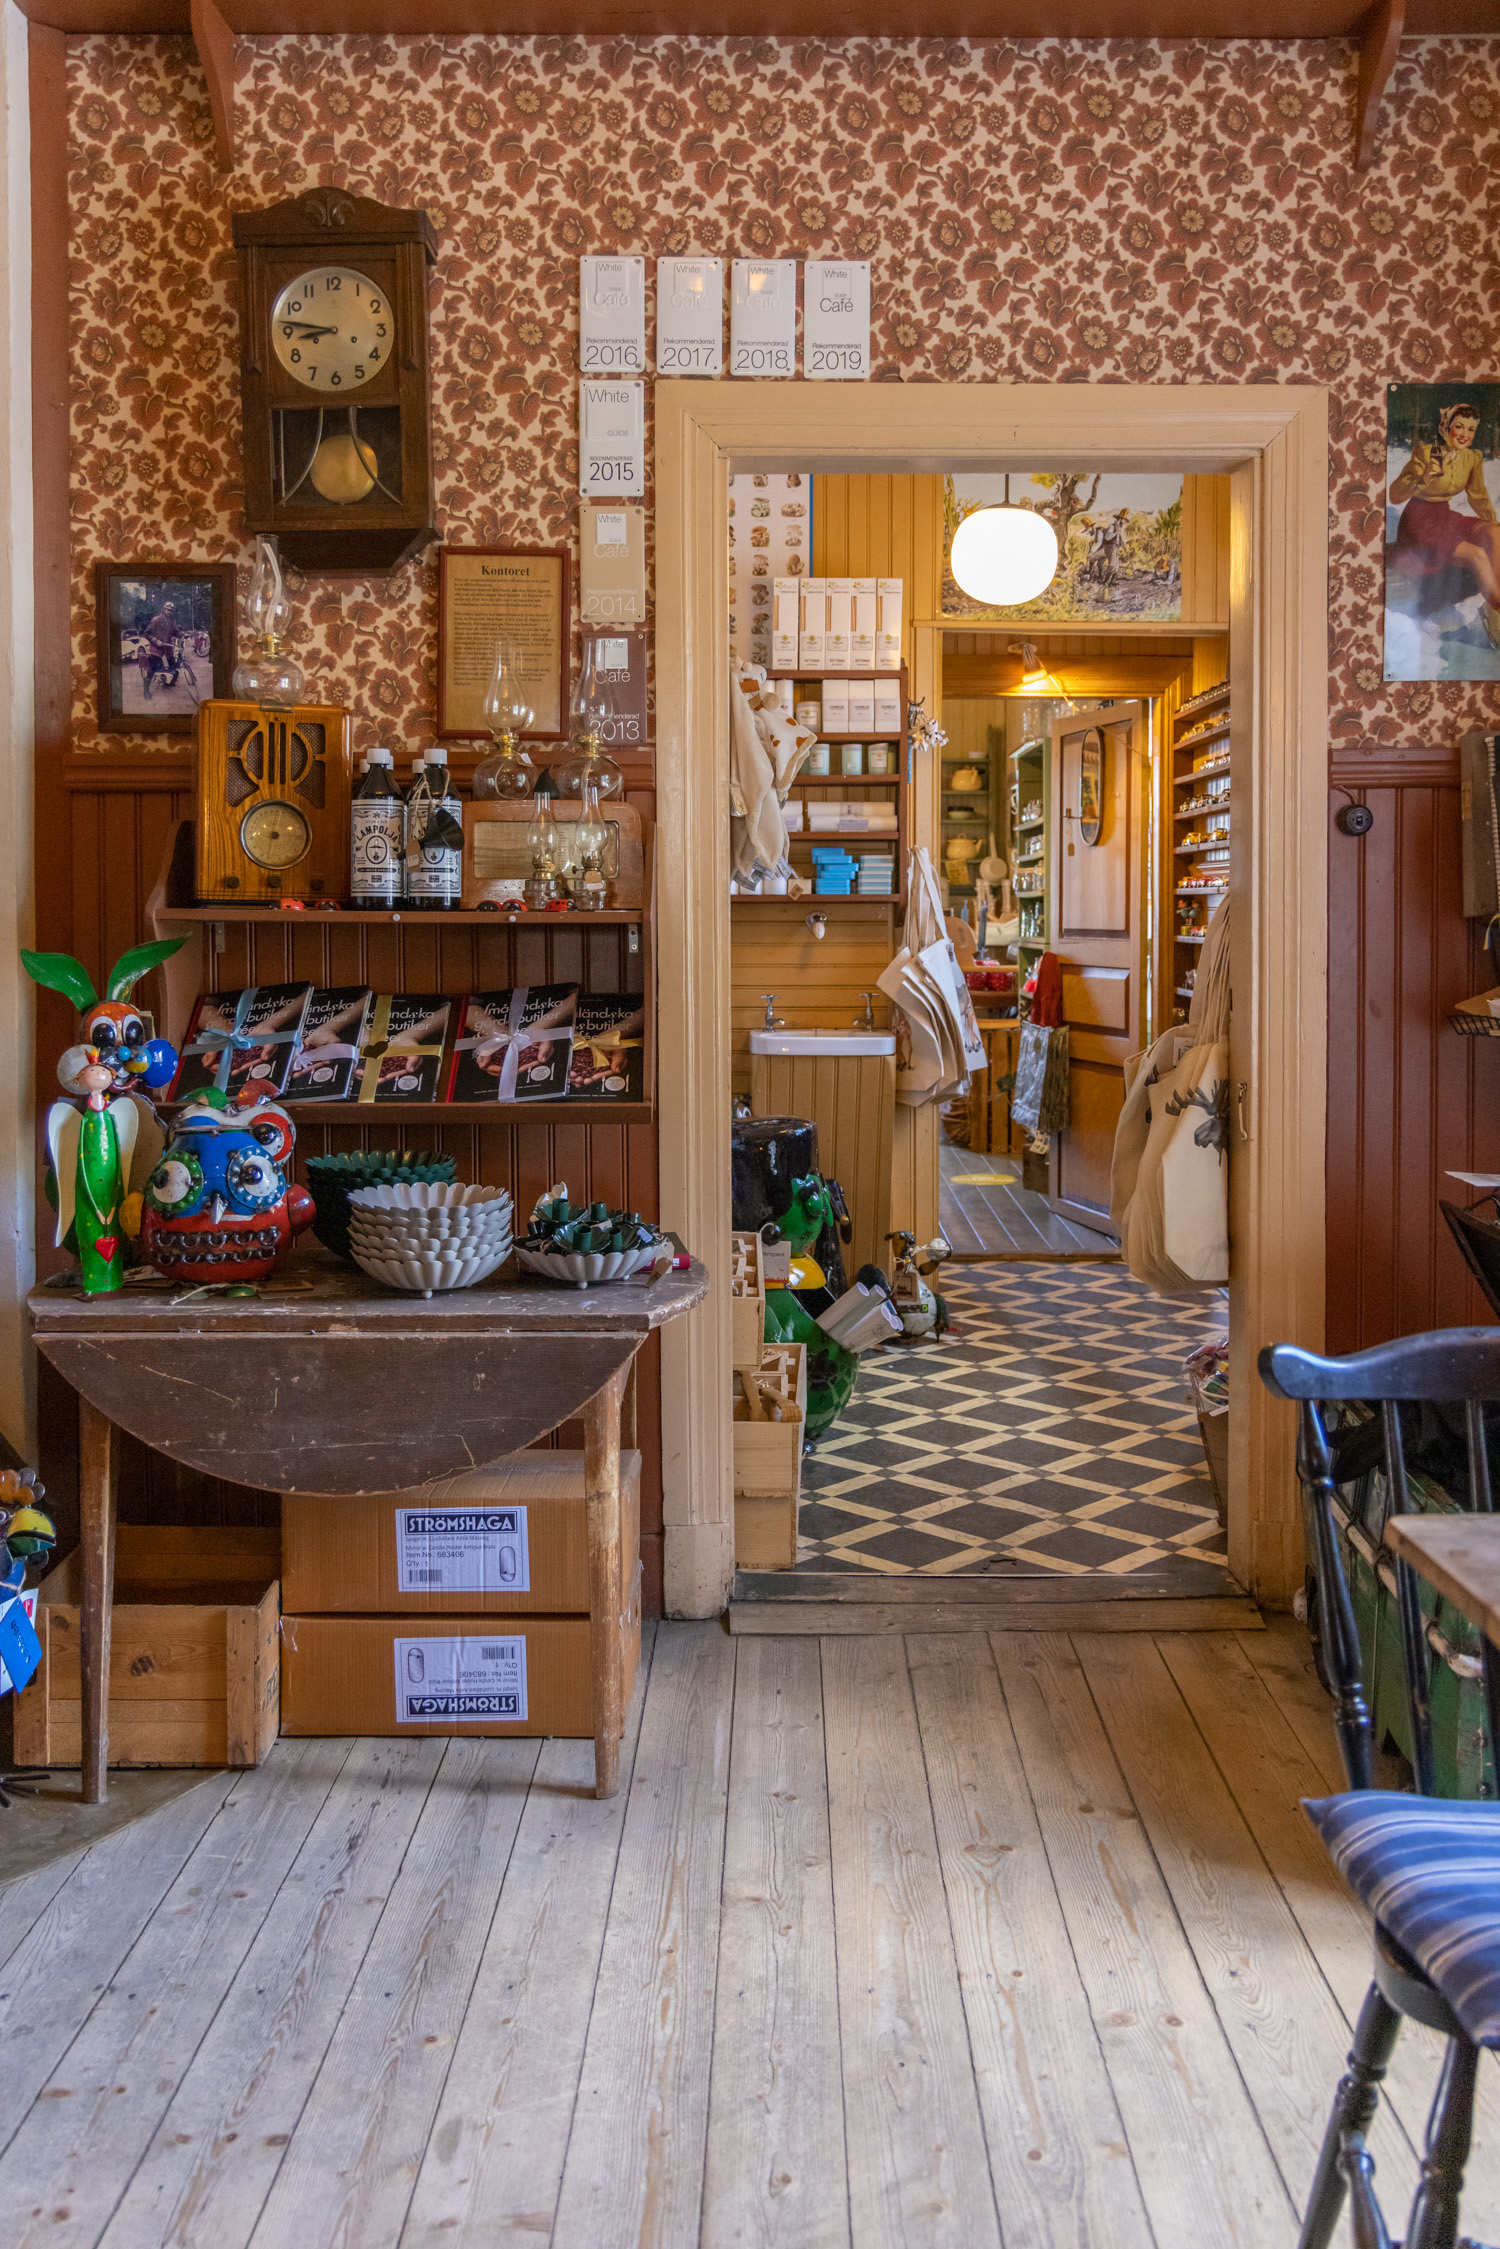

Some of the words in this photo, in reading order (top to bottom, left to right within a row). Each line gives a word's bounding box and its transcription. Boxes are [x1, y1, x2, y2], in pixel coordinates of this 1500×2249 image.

[598, 263, 622, 272] White
[676, 265, 700, 273] White
[750, 266, 774, 275] White
[824, 270, 847, 279] White
[304, 284, 314, 298] 11
[326, 276, 342, 291] 12
[287, 300, 302, 315] 10
[370, 299, 381, 314] 2
[820, 297, 853, 313] Café
[283, 325, 293, 340] 9
[376, 323, 387, 338] 3
[291, 348, 301, 363] 8
[369, 346, 380, 361] 4
[586, 345, 638, 365] 2016
[663, 347, 715, 367] 2017
[737, 349, 788, 369] 2018
[812, 350, 862, 370] 2019
[307, 366, 317, 381] 7
[330, 370, 342, 386] 6
[354, 365, 365, 380] 5
[588, 389, 629, 403] White
[589, 462, 634, 481] 2015
[598, 515, 622, 523] White
[594, 544, 629, 558] Café
[481, 565, 530, 576] Kontoret
[587, 596, 637, 616] 2014
[595, 669, 631, 684] Café
[589, 720, 640, 740] 2013
[356, 825, 399, 843] LAMPOLJA
[476, 997, 563, 1015] Småndska
[409, 1516, 513, 1532] STRÖMSHAGA
[411, 1696, 515, 1712] STRÖMSHAGA
